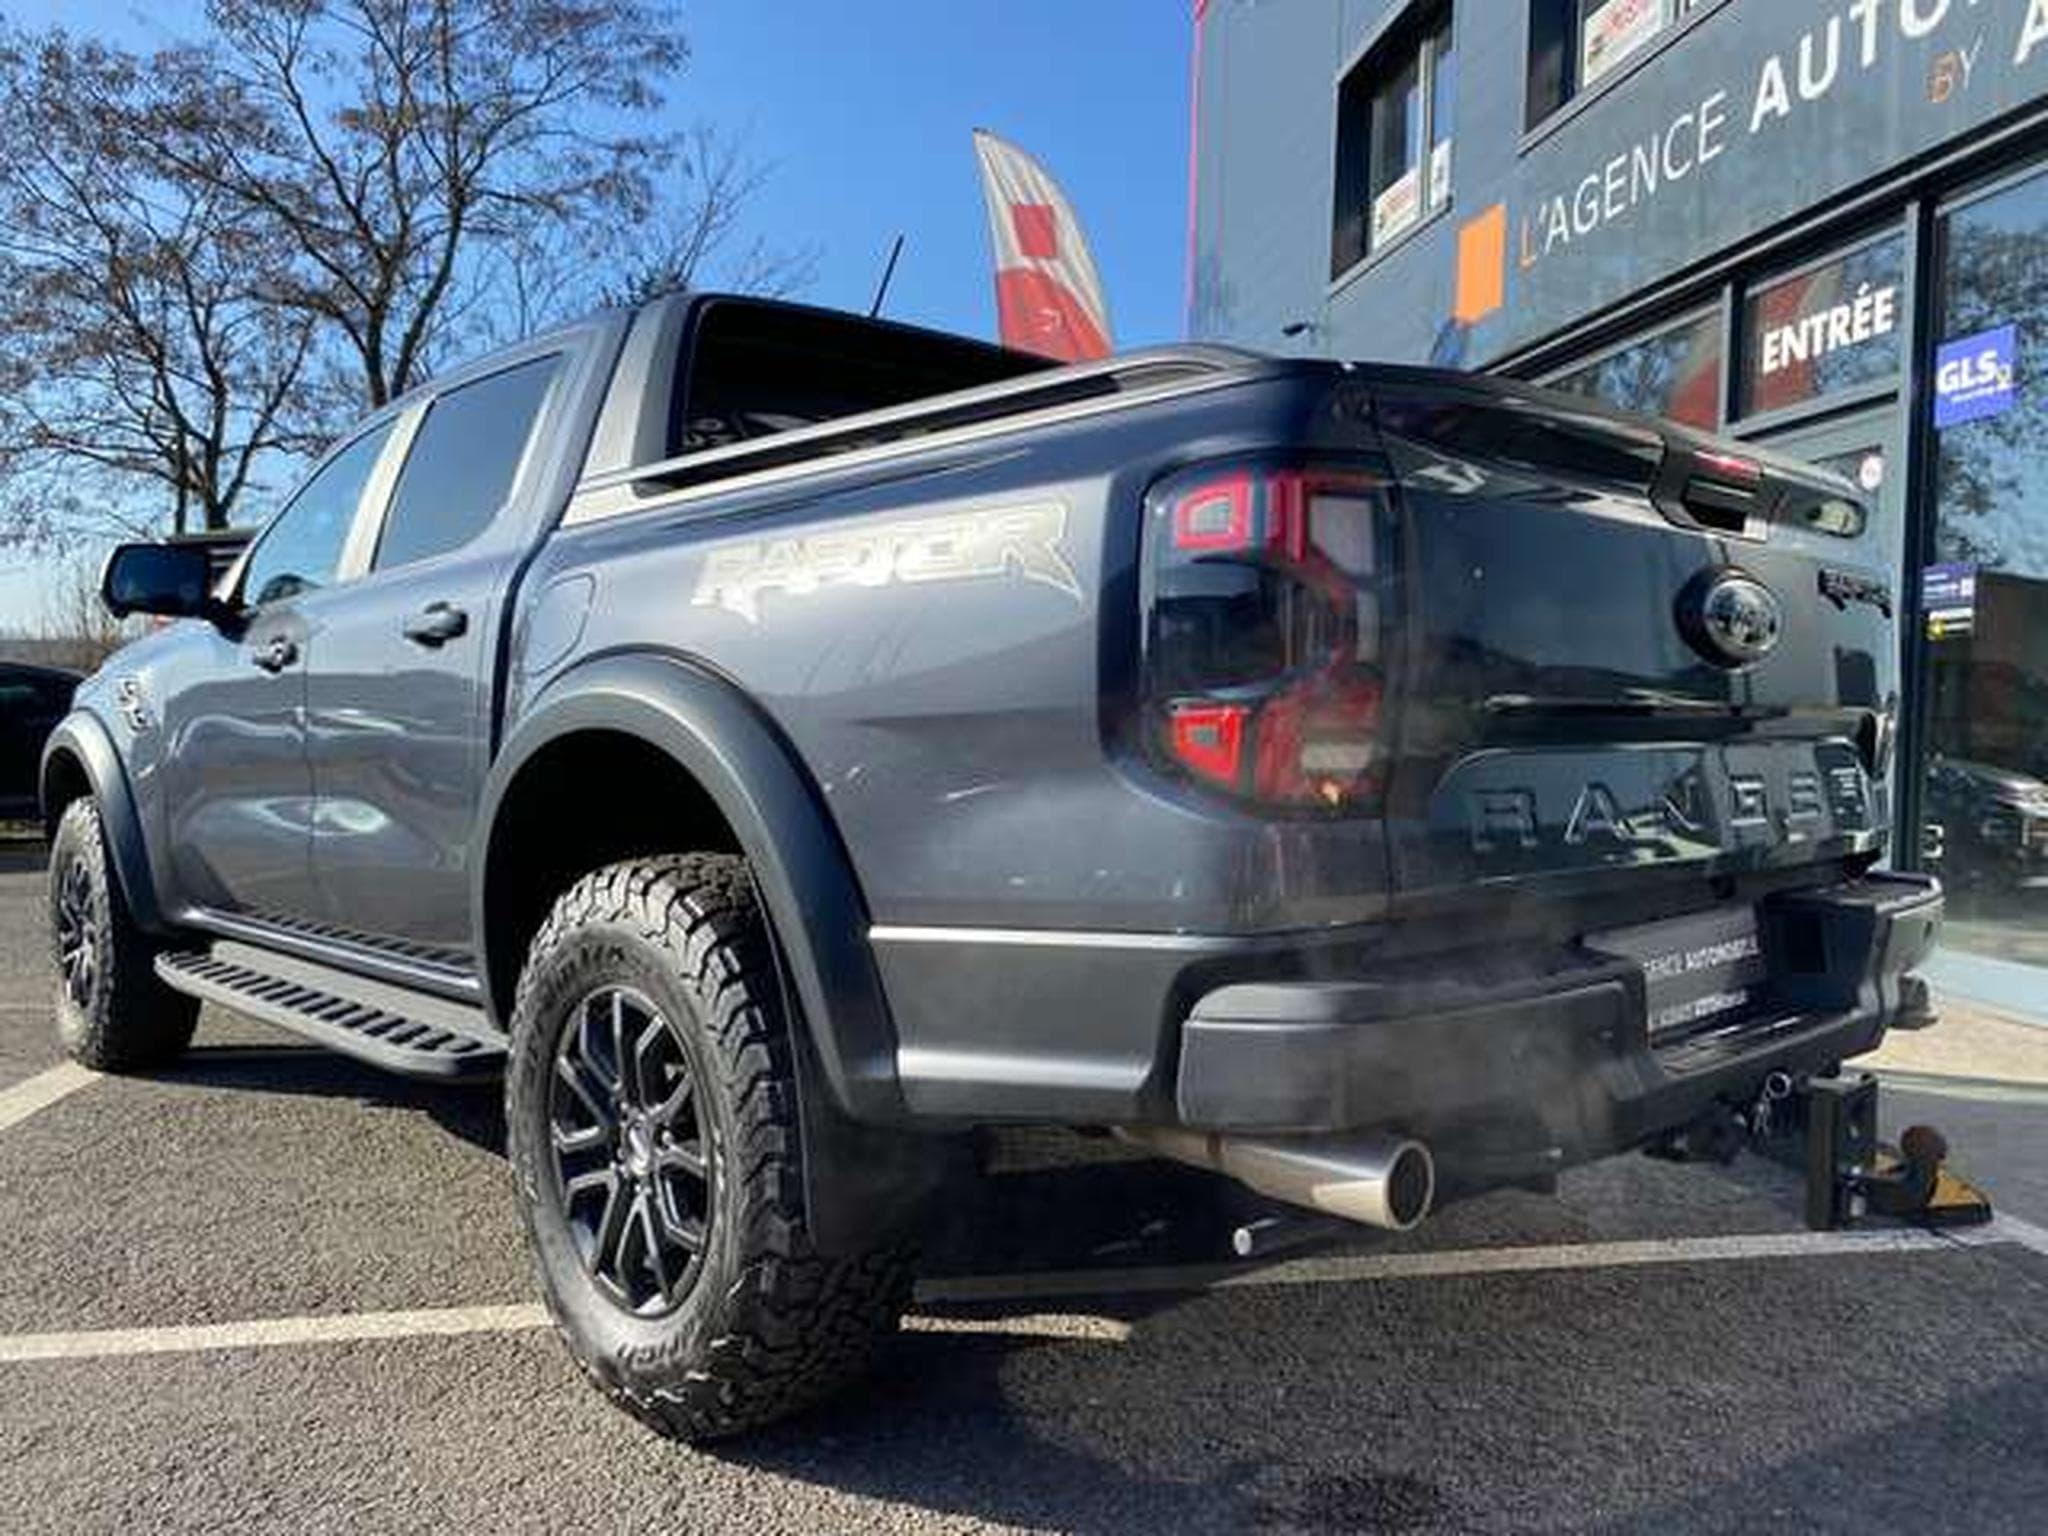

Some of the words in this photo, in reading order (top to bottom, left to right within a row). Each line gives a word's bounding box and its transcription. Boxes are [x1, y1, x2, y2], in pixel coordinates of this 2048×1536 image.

[1519, 89, 1727, 269] L'AGENCE
[1748, 0, 1980, 133] AUTO
[1762, 282, 1895, 375] ENTRÉE
[1937, 349, 2001, 394] GLS
